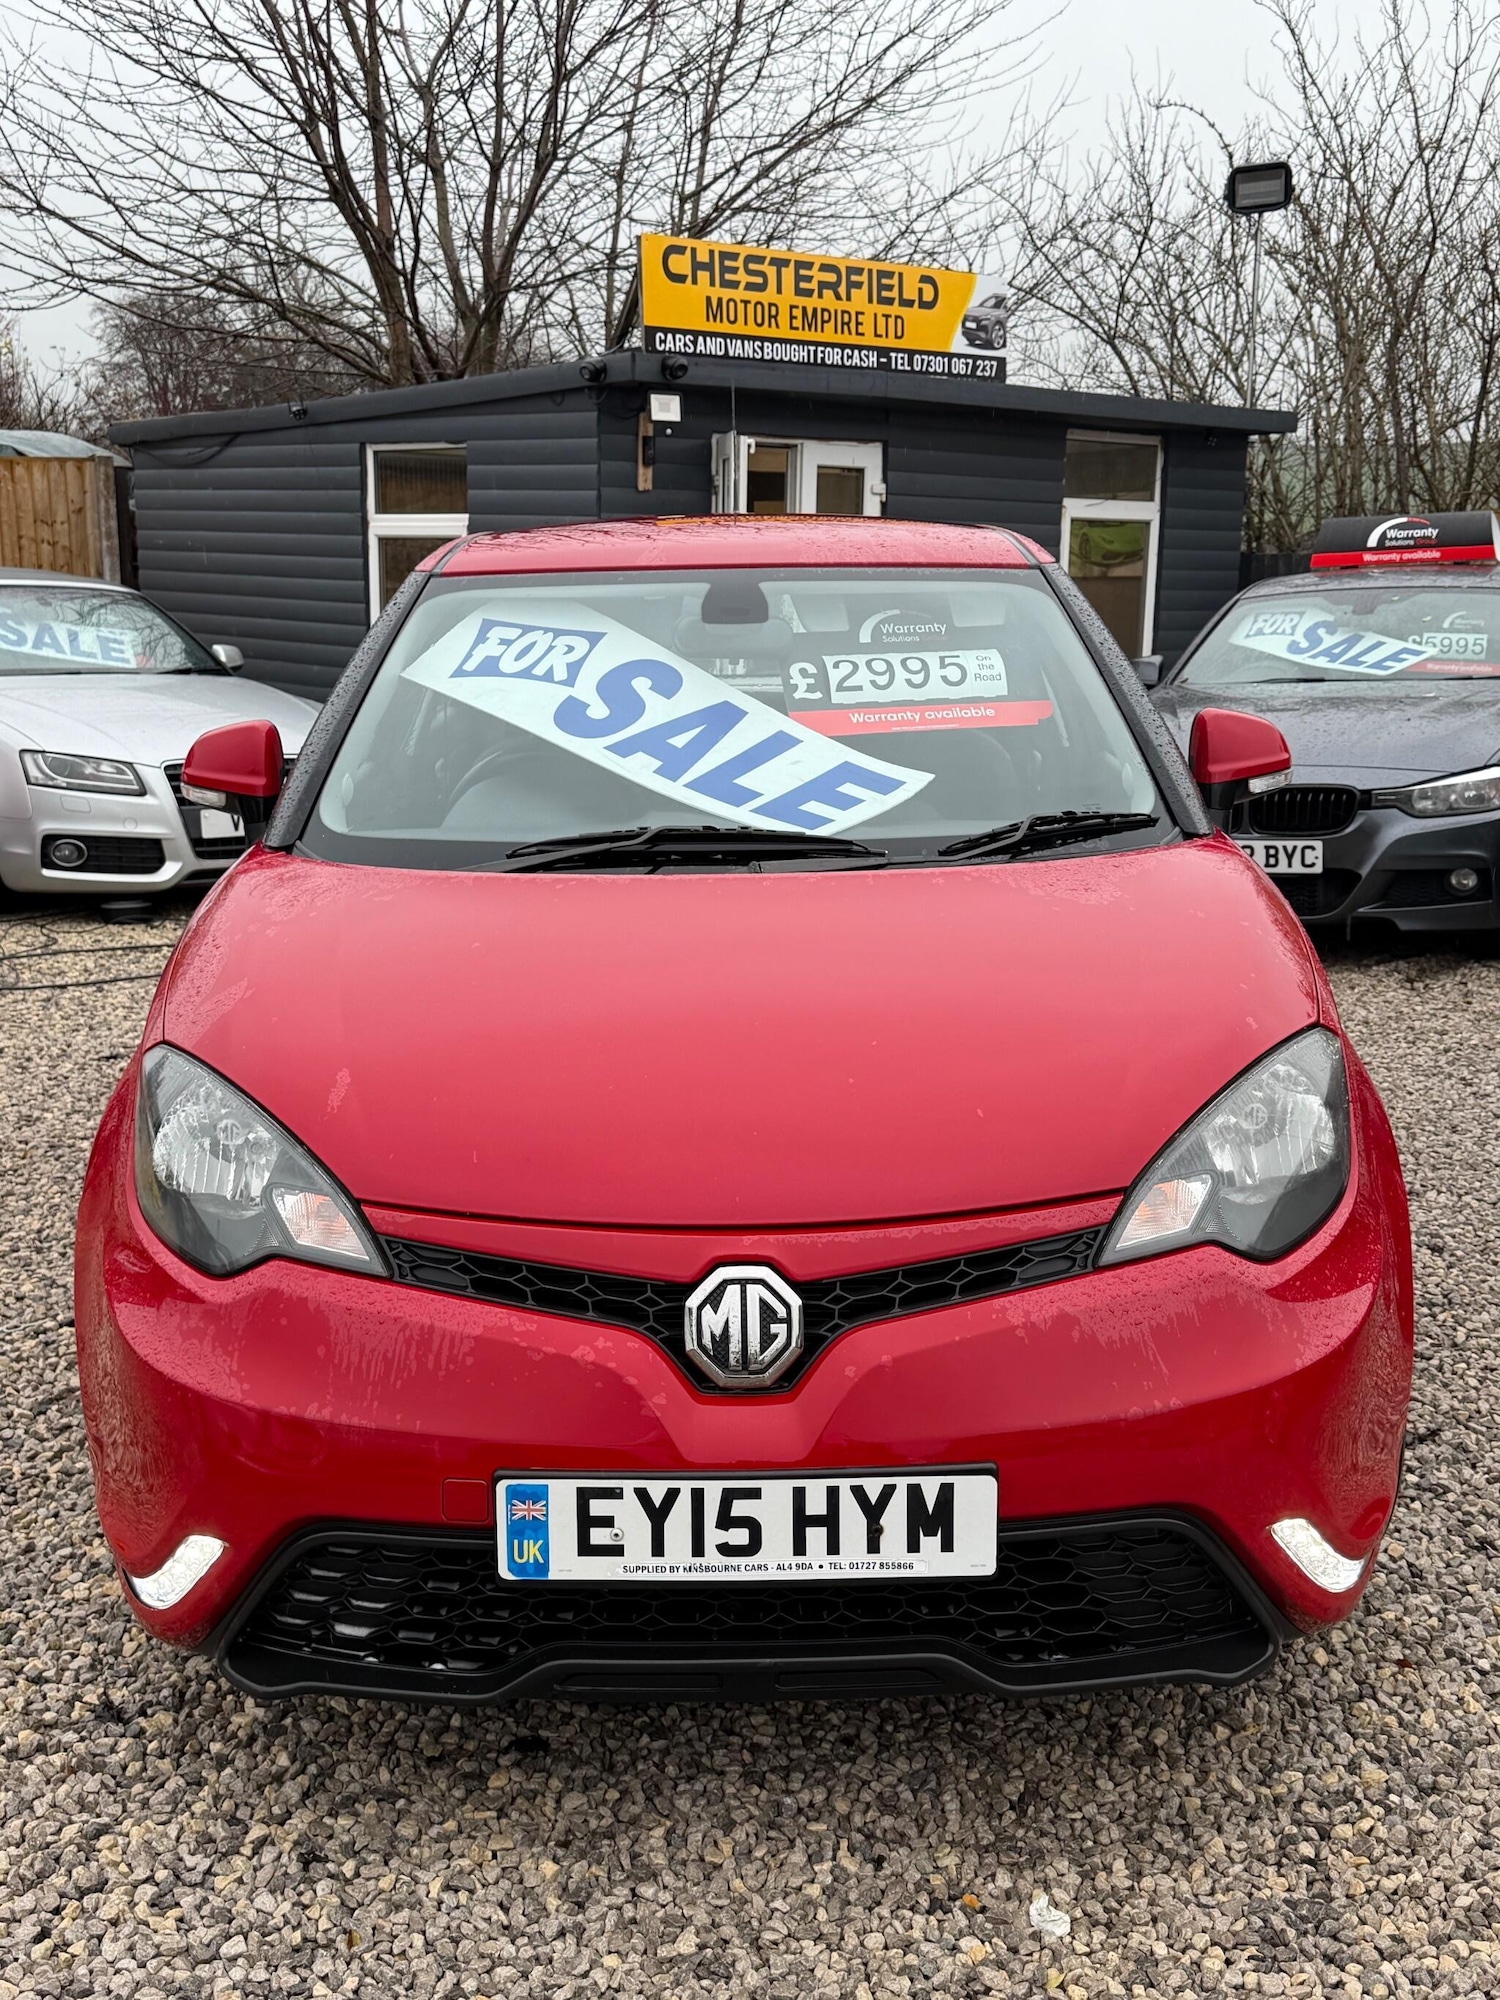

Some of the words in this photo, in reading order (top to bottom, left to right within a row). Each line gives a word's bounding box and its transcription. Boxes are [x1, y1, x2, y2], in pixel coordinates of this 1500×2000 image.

[662, 244, 939, 310] CHESTERFIELD
[705, 295, 779, 330] MOTOR
[789, 305, 865, 336] EMPIRE
[873, 314, 905, 340] LTD
[655, 332, 694, 353] CARS
[696, 335, 725, 356] AND
[726, 338, 762, 359] VANS
[763, 342, 816, 363] BOUGHT
[817, 347, 842, 365] FOR
[843, 349, 877, 368] CASH
[889, 352, 911, 371] TEL
[913, 354, 949, 373] 07301
[951, 357, 973, 375] 067
[975, 360, 997, 377] 237
[1385, 539, 1414, 547] Solutions
[1386, 527, 1439, 539] Warranty
[1362, 553, 1401, 562] Warranty
[1402, 550, 1441, 560] available
[880, 622, 946, 635] Warranty
[1248, 612, 1300, 636] FOR
[0, 619, 131, 664] SALE
[882, 635, 920, 643] Solutions
[1287, 620, 1427, 671] SALE
[462, 626, 590, 684] FOR
[974, 671, 1002, 682] Road
[849, 711, 920, 724] Warranty
[925, 706, 996, 719] available
[553, 658, 908, 831] SALE
[1264, 845, 1318, 868] BYC
[701, 1284, 787, 1371] MG
[576, 1486, 762, 1558] EY15
[792, 1482, 955, 1556] HYM
[513, 1539, 544, 1564] UK
[622, 1565, 666, 1574] SUPPLIED
[669, 1565, 681, 1573] BY
[744, 1563, 769, 1572] CARS
[776, 1563, 793, 1571] AL4
[795, 1562, 813, 1571] 9DA
[828, 1562, 847, 1570] TEL:
[849, 1562, 876, 1570] 01727
[879, 1562, 914, 1570] 855866
